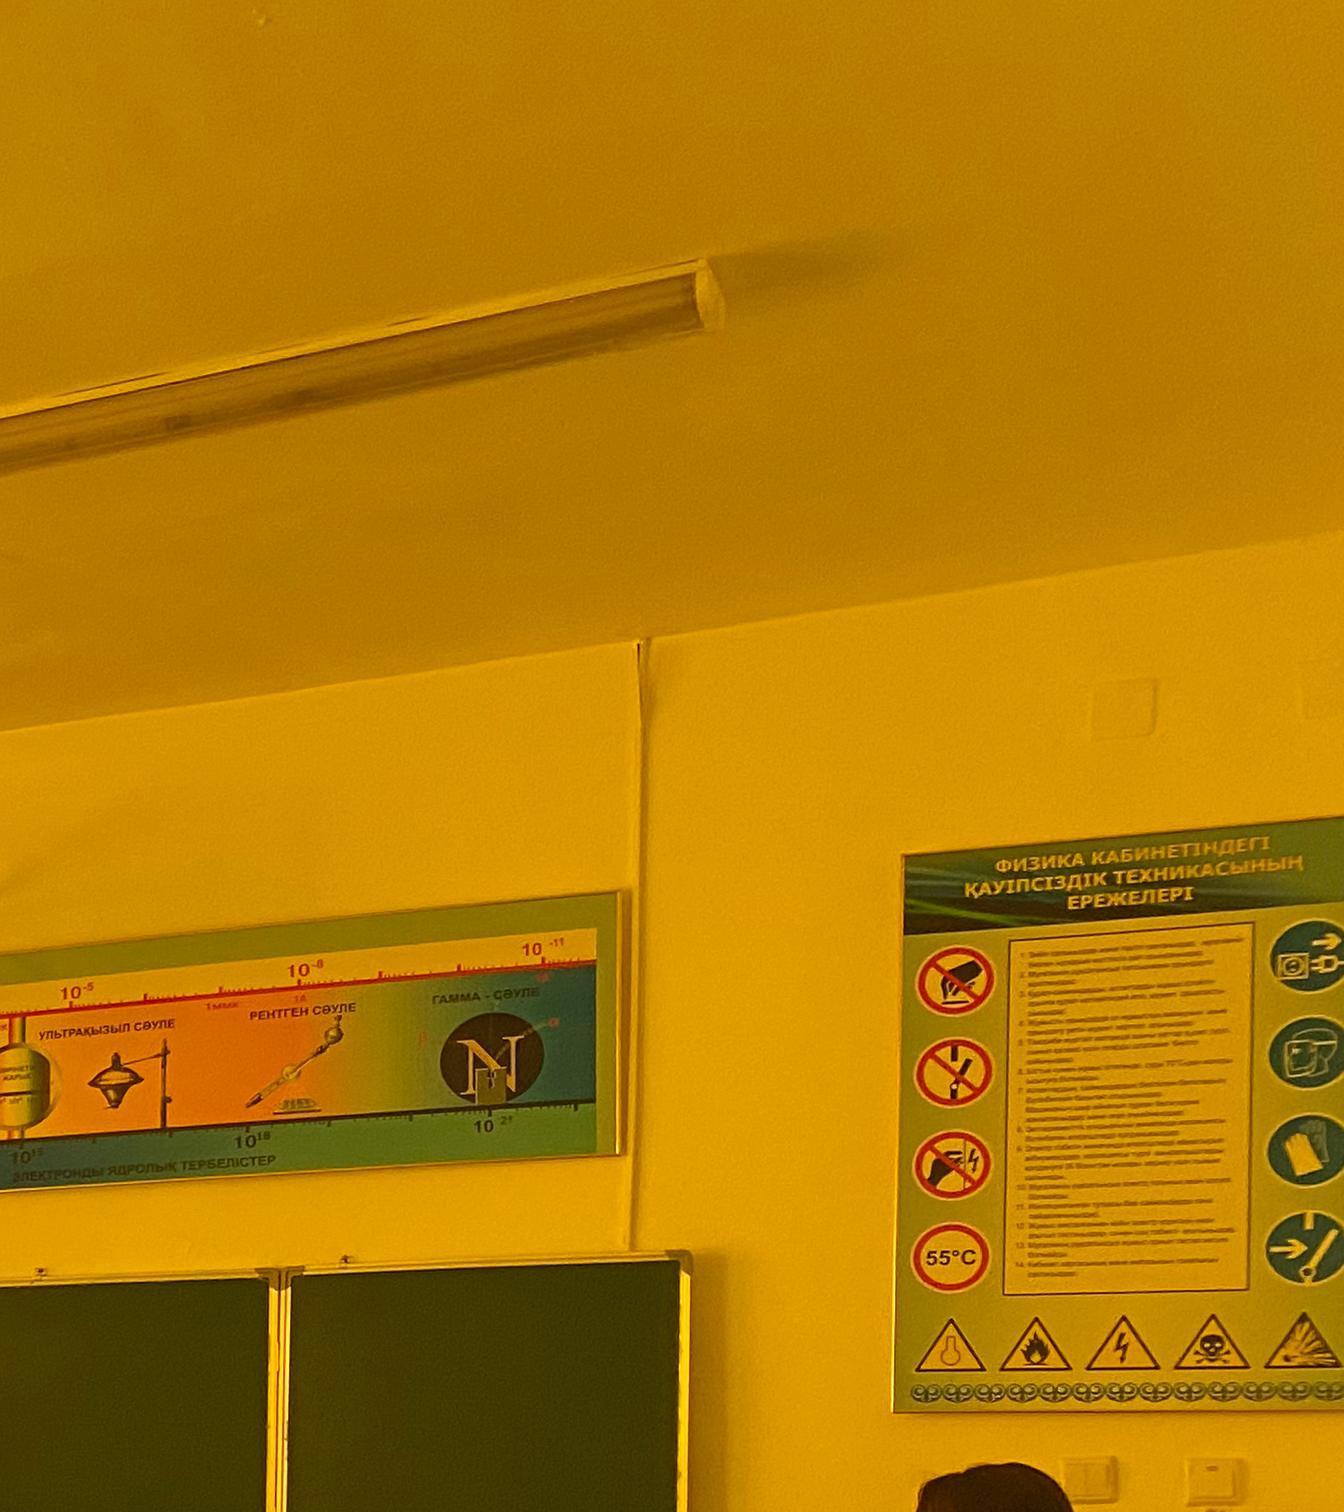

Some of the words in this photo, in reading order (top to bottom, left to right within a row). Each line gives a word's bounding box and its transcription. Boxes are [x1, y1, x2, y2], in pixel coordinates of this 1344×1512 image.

[994, 852, 1085, 874] ФИЗИКА
[1091, 836, 1271, 866] КАБИНЕТІНДЕГІ
[963, 869, 1107, 900] ҚАУІПСІЗДІК
[1112, 854, 1304, 886] ТЕХНИКАСЫНЫҢ
[1066, 886, 1195, 911] ЕРЕЖЕЛЕРІ
[431, 991, 481, 1005] ГАММА
[249, 1006, 310, 1022] РЕНТГЕН
[312, 1001, 357, 1017] СӘУЛЕ
[38, 1023, 131, 1041] УЛЬТРАҚЫЗЫЛ
[133, 1018, 177, 1033] СӘУЛЕ
[180, 1153, 277, 1172] ТЕРБЕЛІСТЕР
[925, 1249, 977, 1266] 55°C
